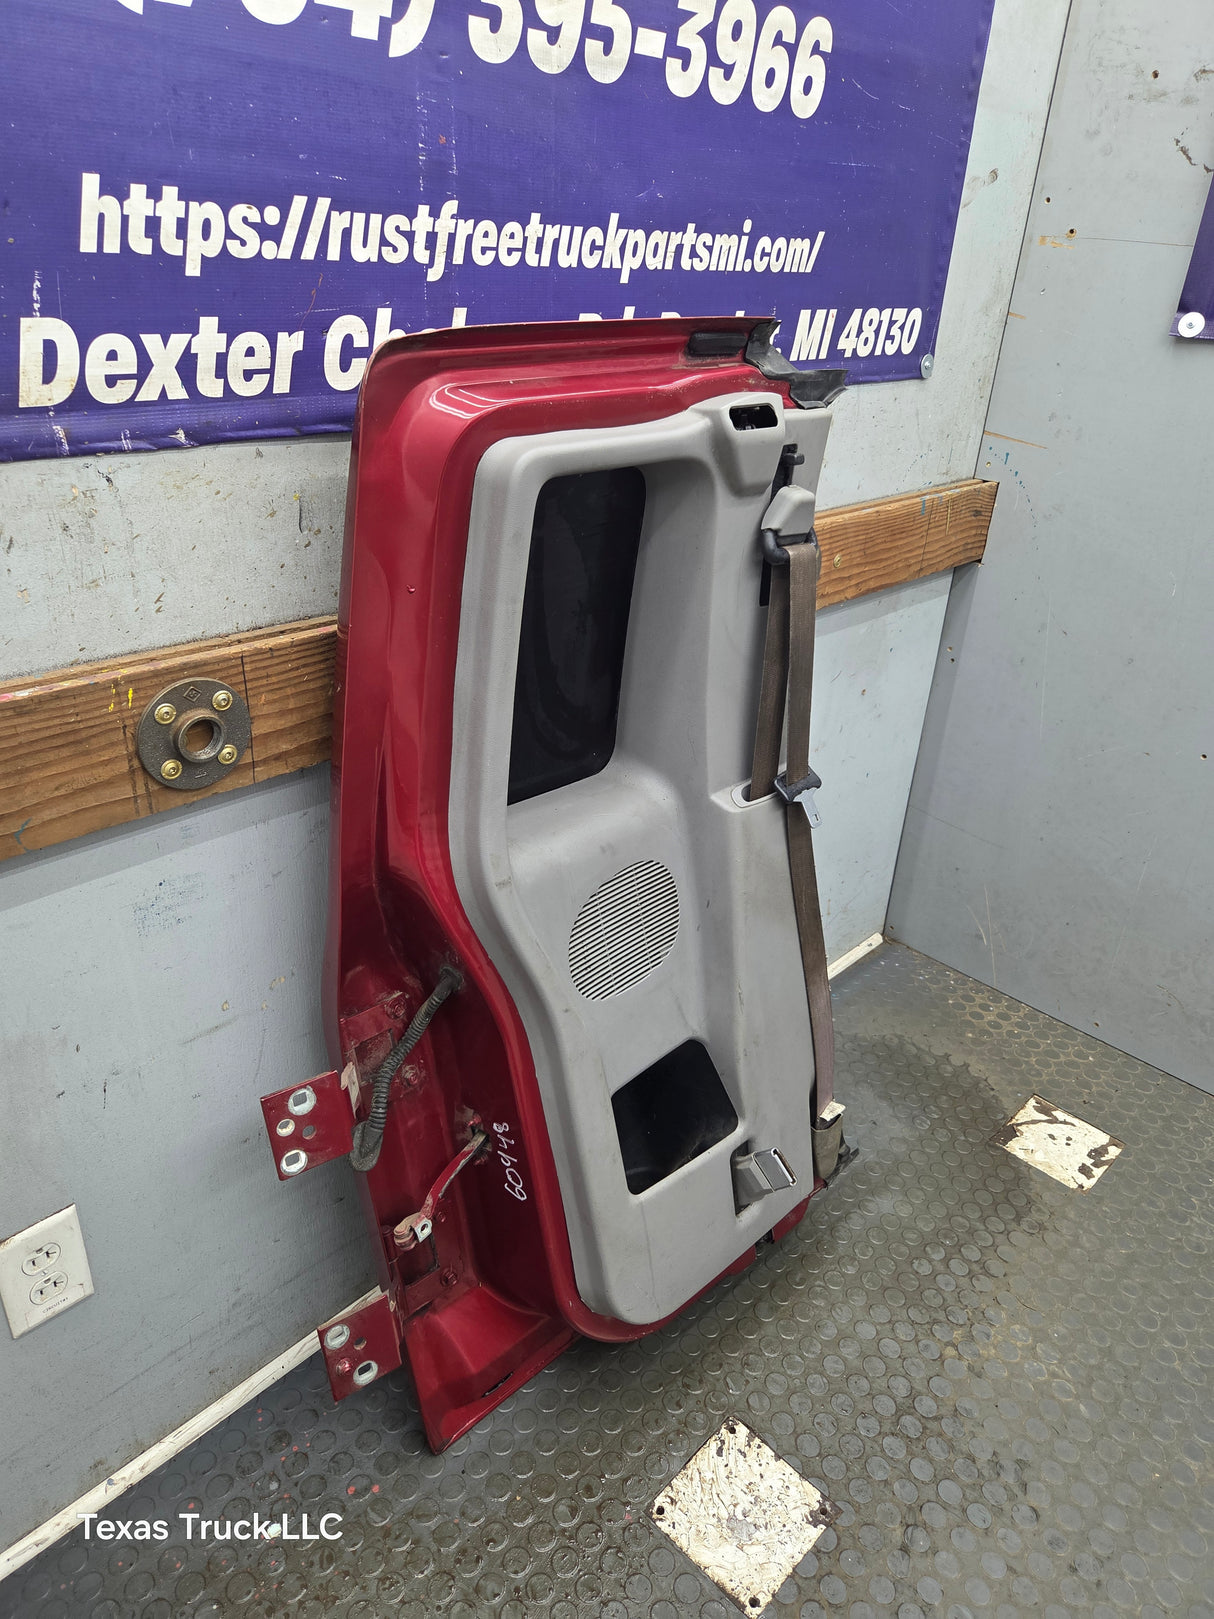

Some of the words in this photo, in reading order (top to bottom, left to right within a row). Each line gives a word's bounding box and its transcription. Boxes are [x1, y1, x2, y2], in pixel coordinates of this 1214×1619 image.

[80, 171, 826, 283] https://rustfreetruckpartsmi.com/
[19, 303, 304, 408] Dexter
[788, 308, 837, 361] MI
[837, 307, 923, 358] 48130
